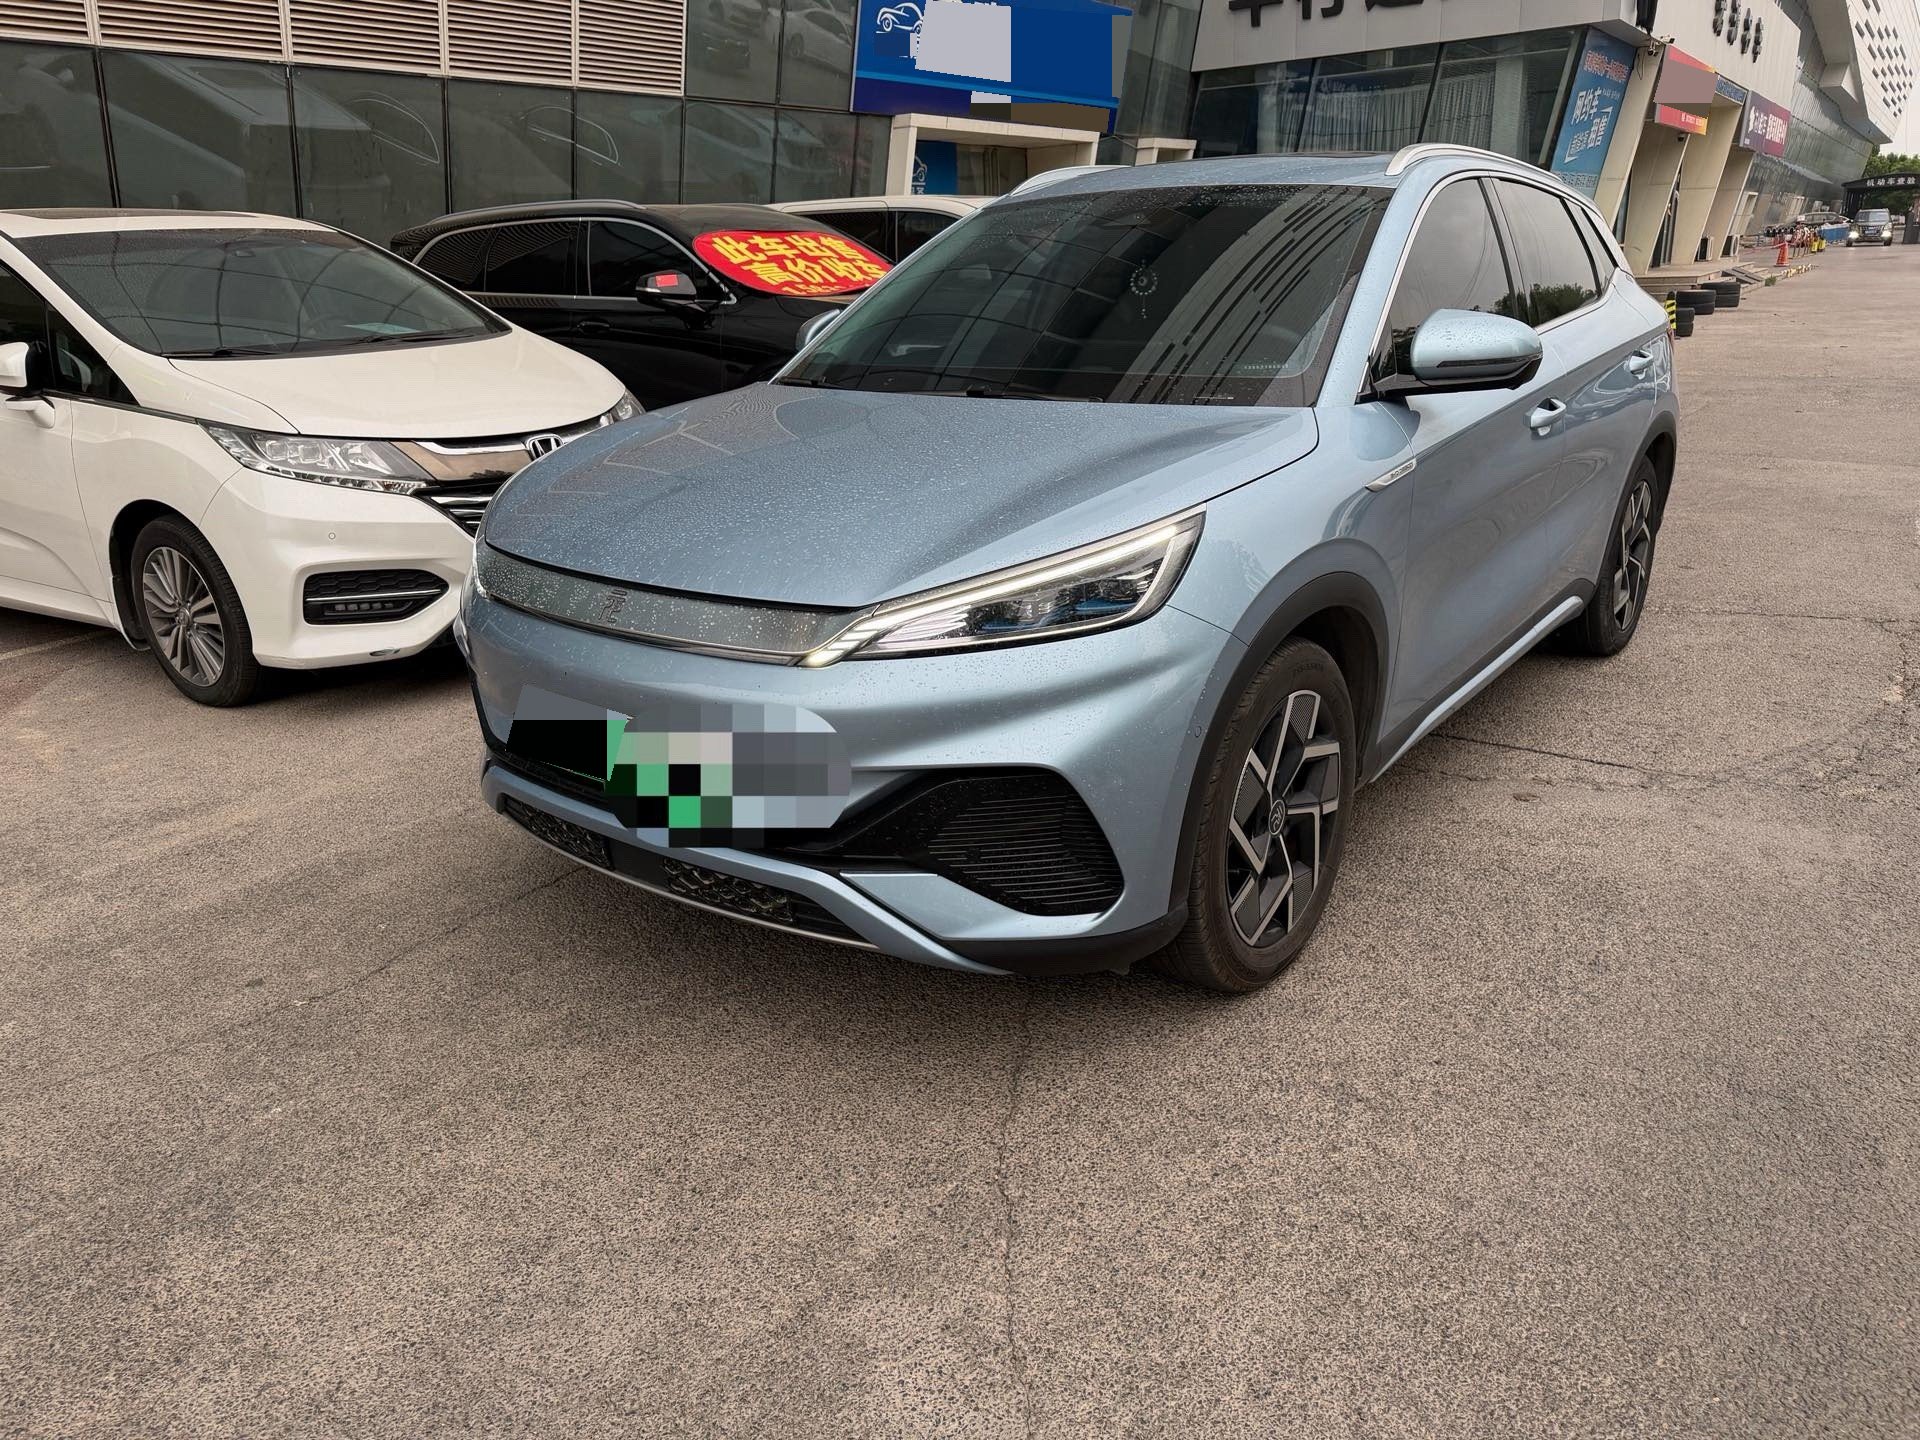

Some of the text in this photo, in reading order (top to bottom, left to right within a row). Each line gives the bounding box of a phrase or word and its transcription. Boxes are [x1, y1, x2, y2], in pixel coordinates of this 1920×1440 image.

[1867, 177, 1916, 187] 机动车查验
[712, 234, 869, 264] 此车出售
[741, 258, 886, 286] 高价收车
